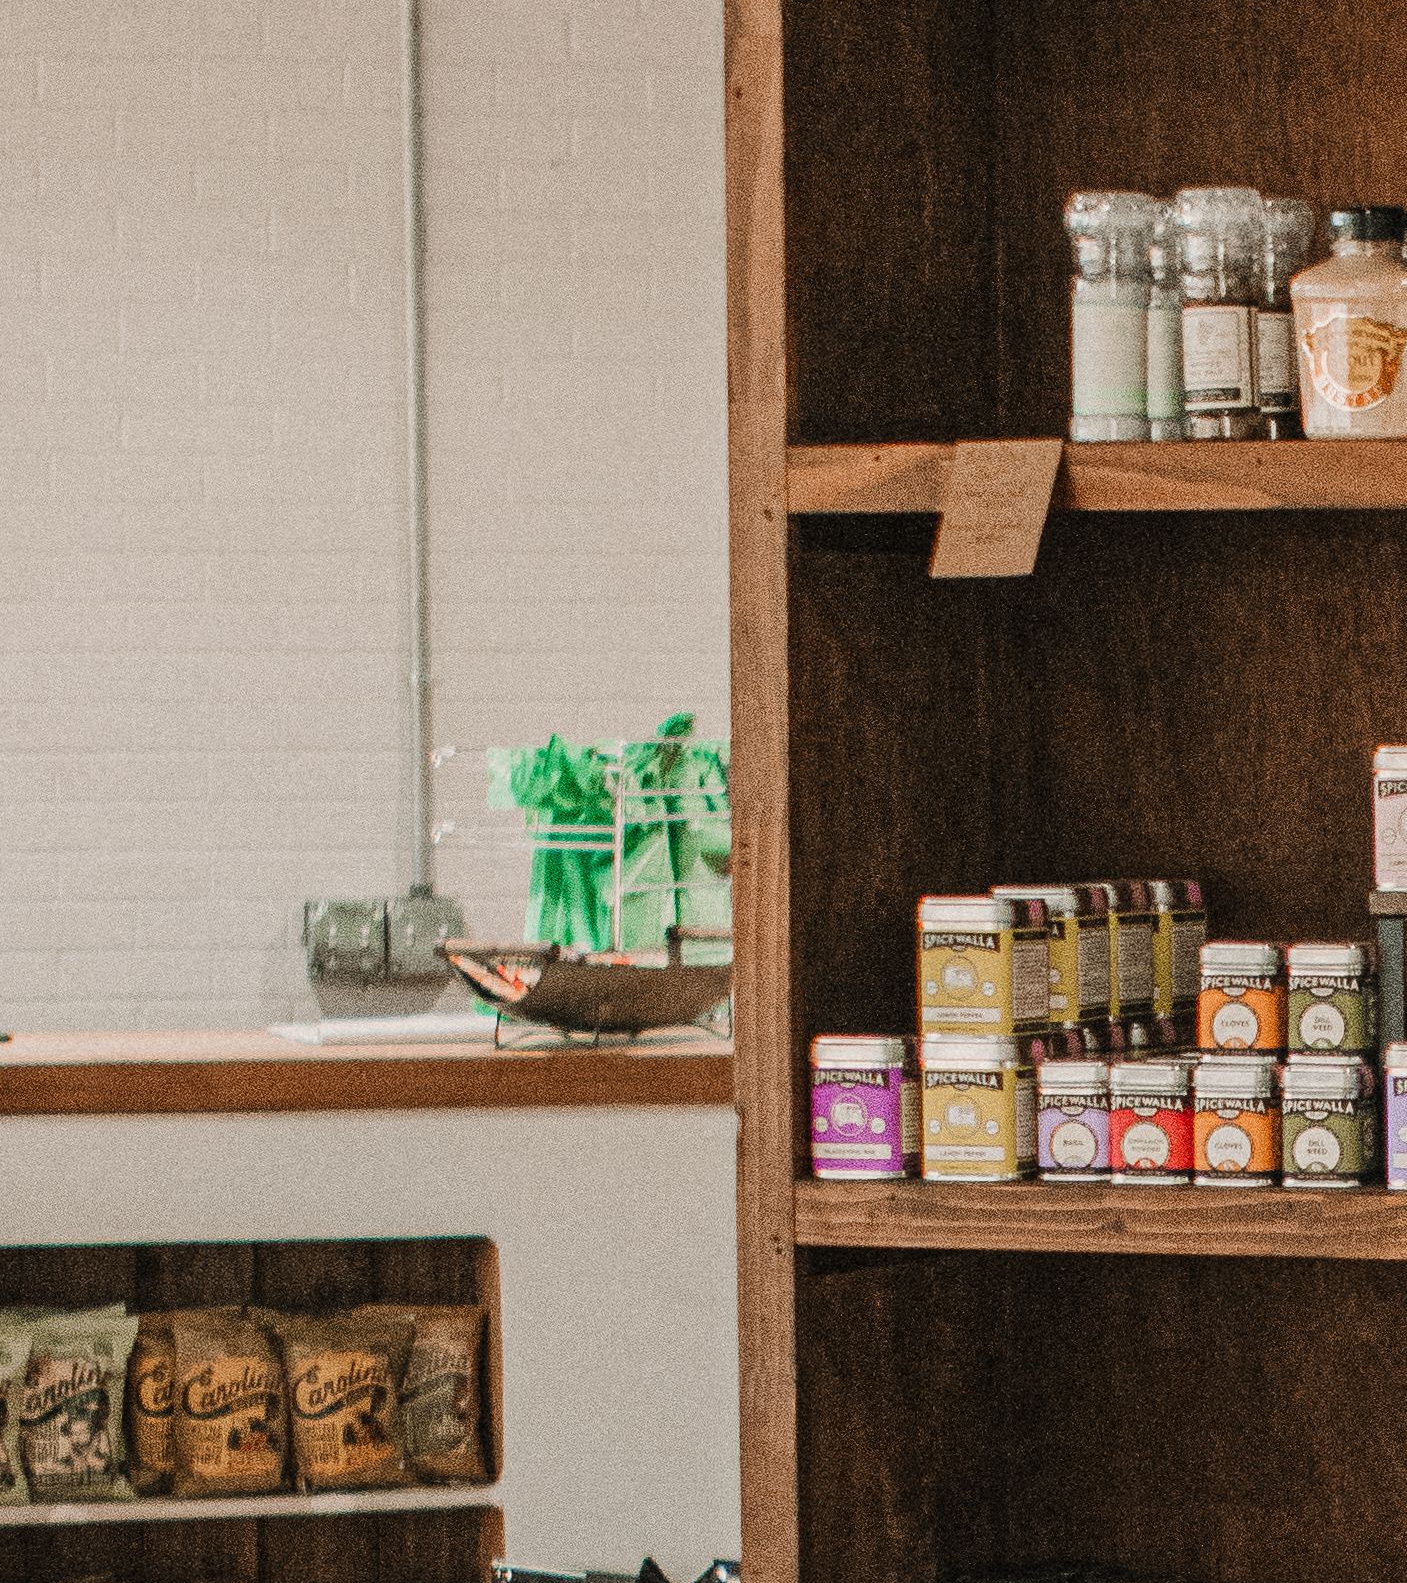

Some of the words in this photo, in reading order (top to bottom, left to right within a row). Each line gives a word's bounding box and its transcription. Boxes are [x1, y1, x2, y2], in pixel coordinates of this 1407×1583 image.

[924, 932, 996, 949] SPICEWALLA
[1202, 977, 1271, 992] SPICEWALLA
[927, 1071, 999, 1088] SPICEWALLA
